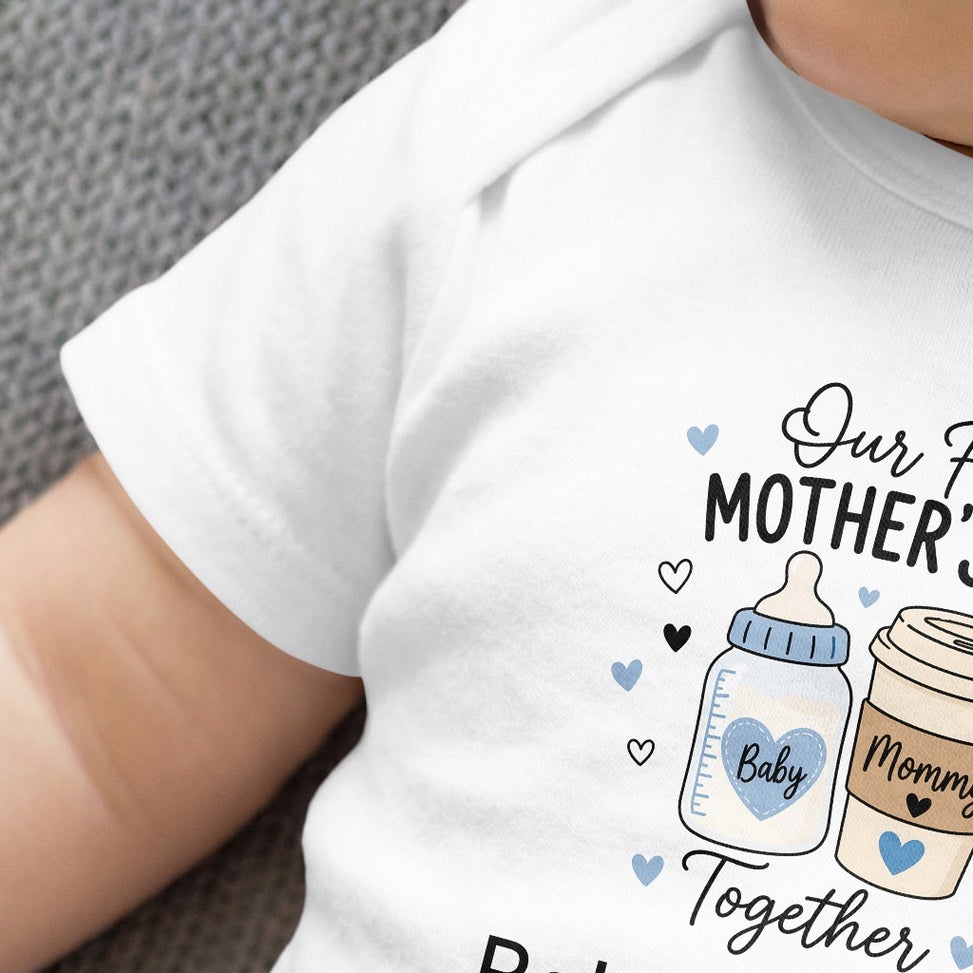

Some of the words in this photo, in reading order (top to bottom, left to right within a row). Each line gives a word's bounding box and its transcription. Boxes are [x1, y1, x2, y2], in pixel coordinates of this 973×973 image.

[781, 382, 924, 478] Our
[736, 742, 808, 801] Baby
[681, 849, 931, 973] Together
